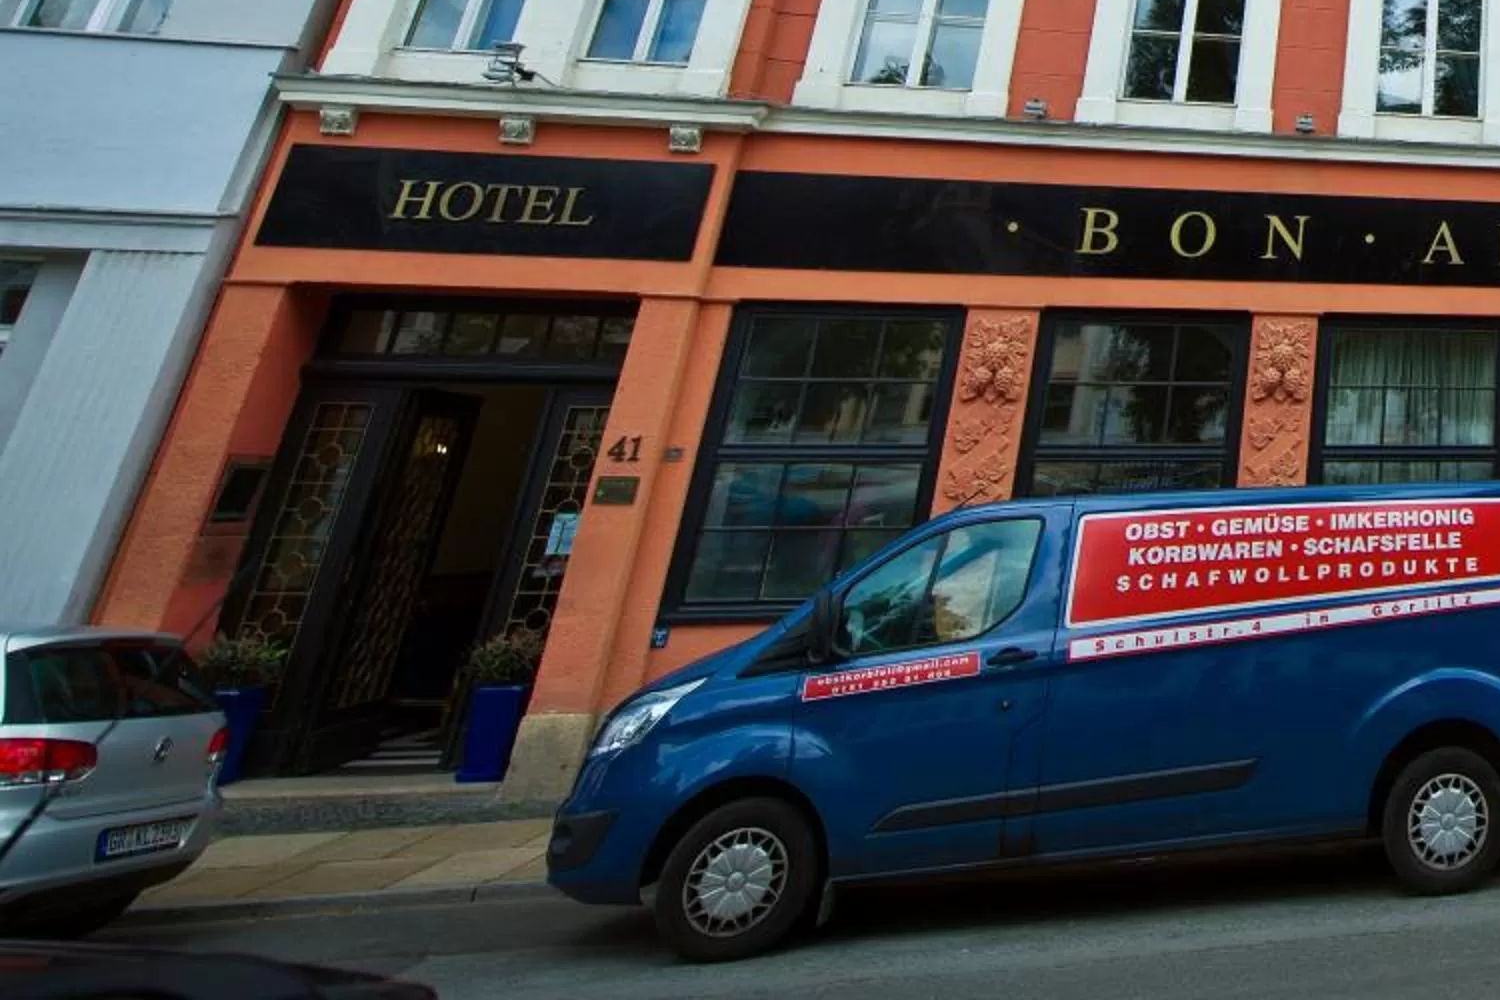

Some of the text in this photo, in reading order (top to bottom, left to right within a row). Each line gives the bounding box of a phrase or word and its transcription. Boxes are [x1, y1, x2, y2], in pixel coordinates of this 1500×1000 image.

[387, 178, 593, 226] HOTEL
[1075, 206, 1311, 261] BON
[607, 435, 642, 463] 41
[1125, 507, 1474, 541] OBST GEMÜSE IMKERHONIG
[1128, 532, 1462, 566] KORBWAREN SCHAFSFELLE
[1116, 557, 1480, 592] SCHAFWOLLPRODUKTE
[1306, 613, 1330, 627] in
